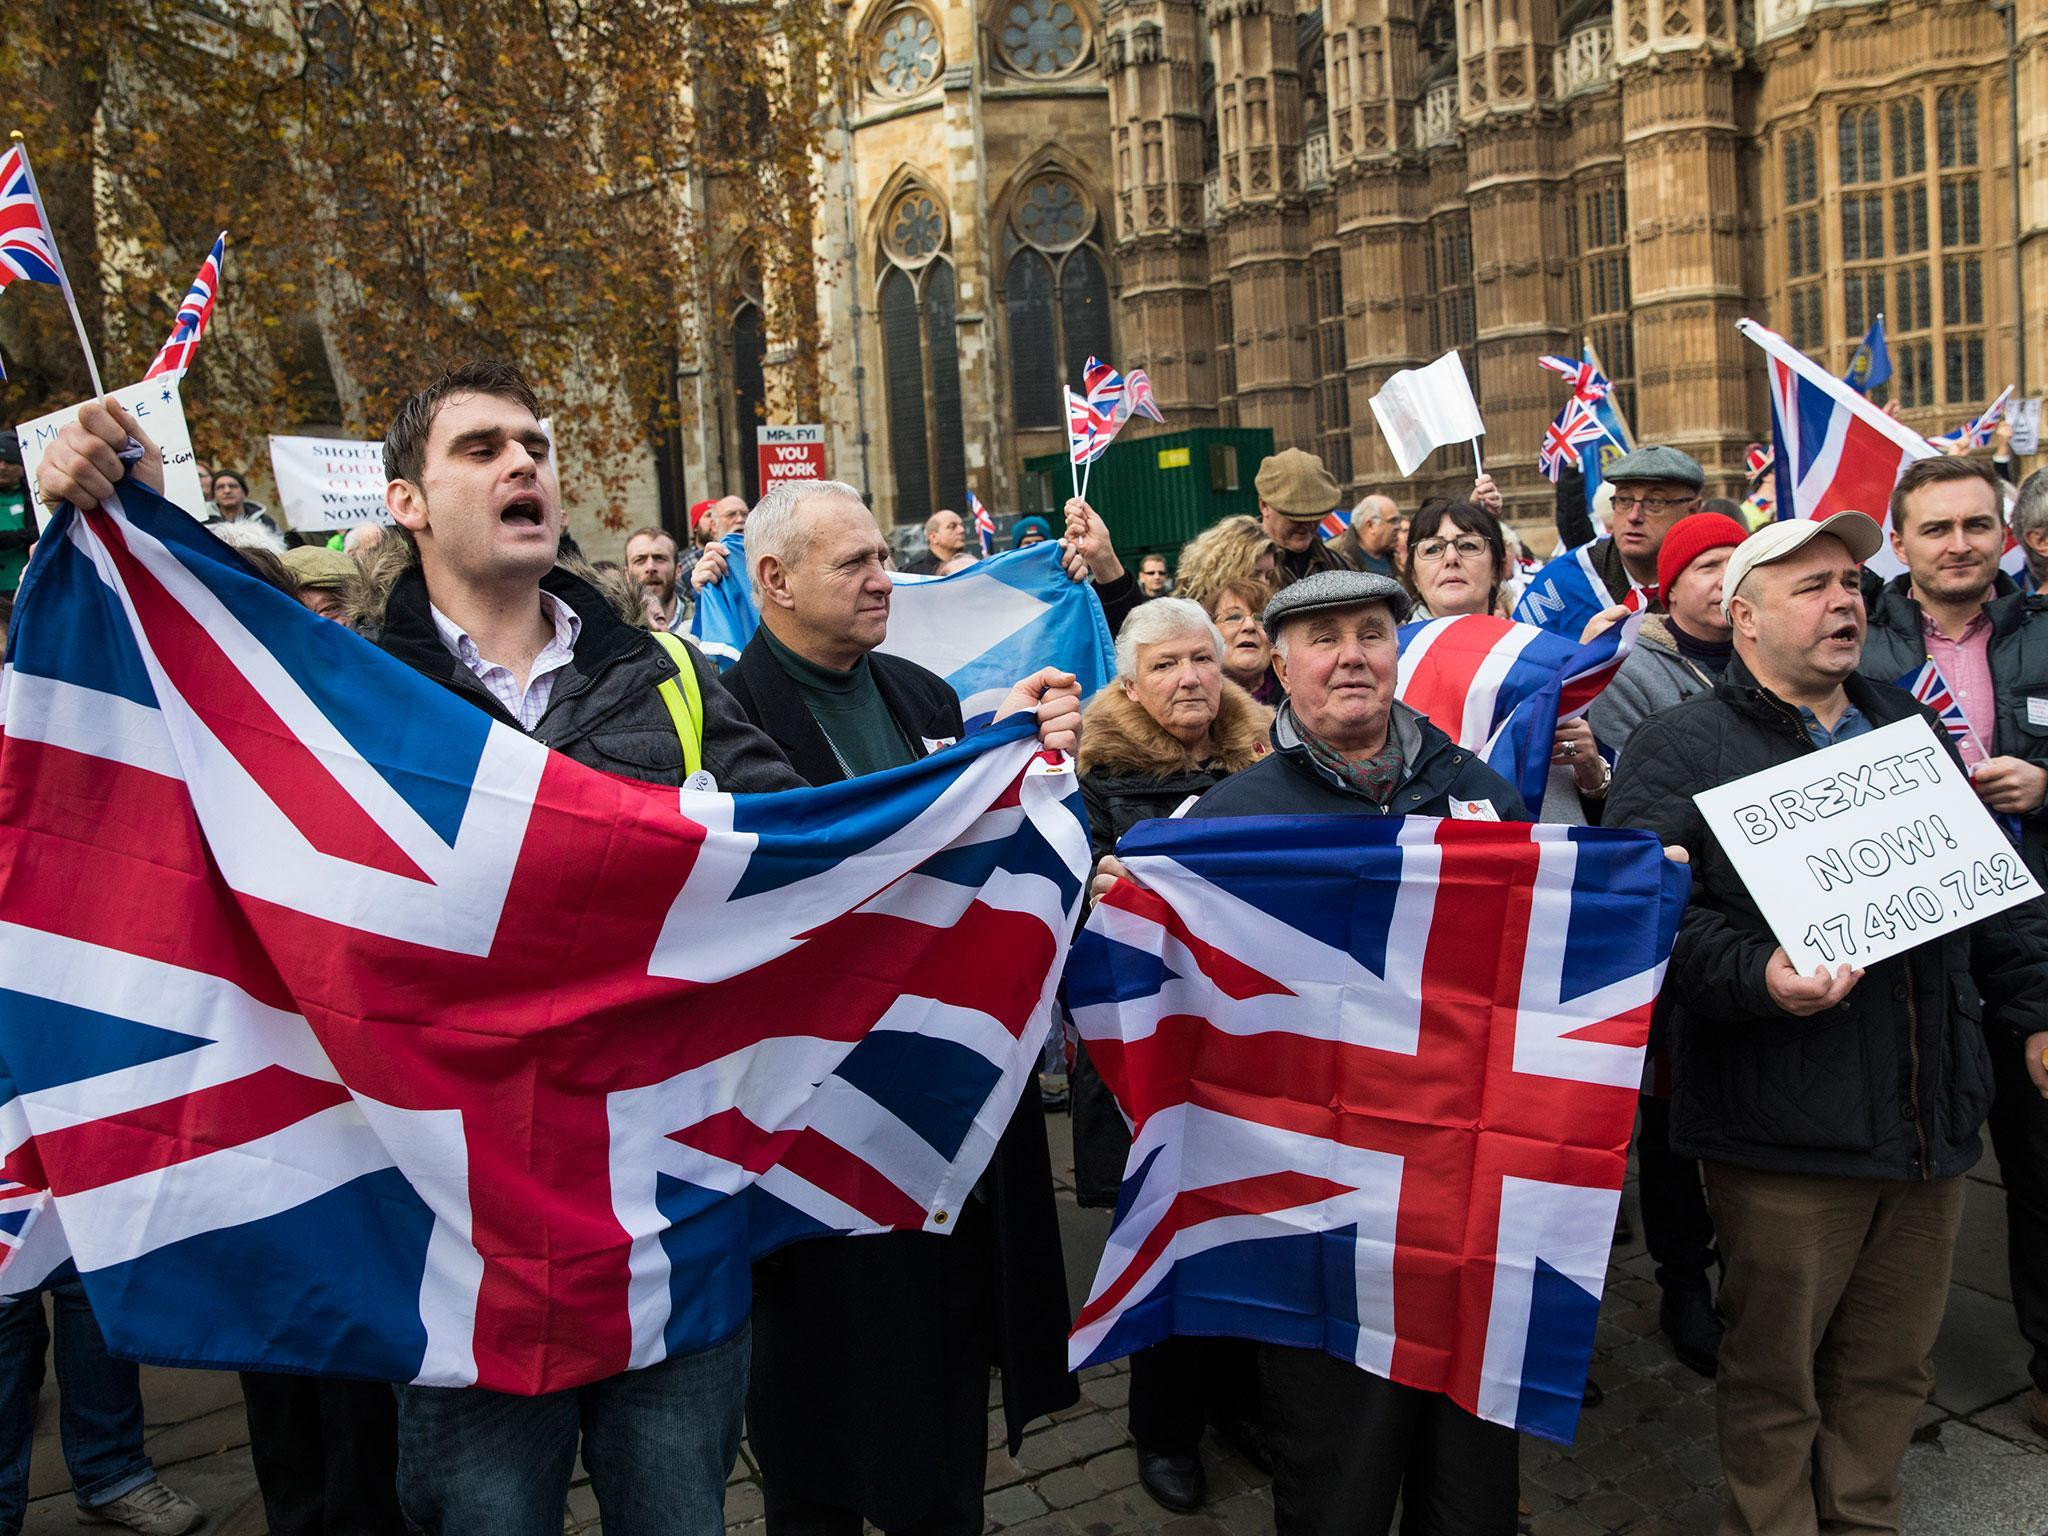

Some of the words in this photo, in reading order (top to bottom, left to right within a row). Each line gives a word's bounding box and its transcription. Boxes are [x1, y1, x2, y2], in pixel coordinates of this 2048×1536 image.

[797, 429, 816, 440] FYI
[776, 446, 808, 461] YOU
[768, 462, 817, 477] WORK
[323, 508, 370, 521] NOW
[1734, 747, 1941, 845] BREXIT
[1806, 815, 1958, 891] NOW!
[1804, 853, 2029, 962] 17,410,742
